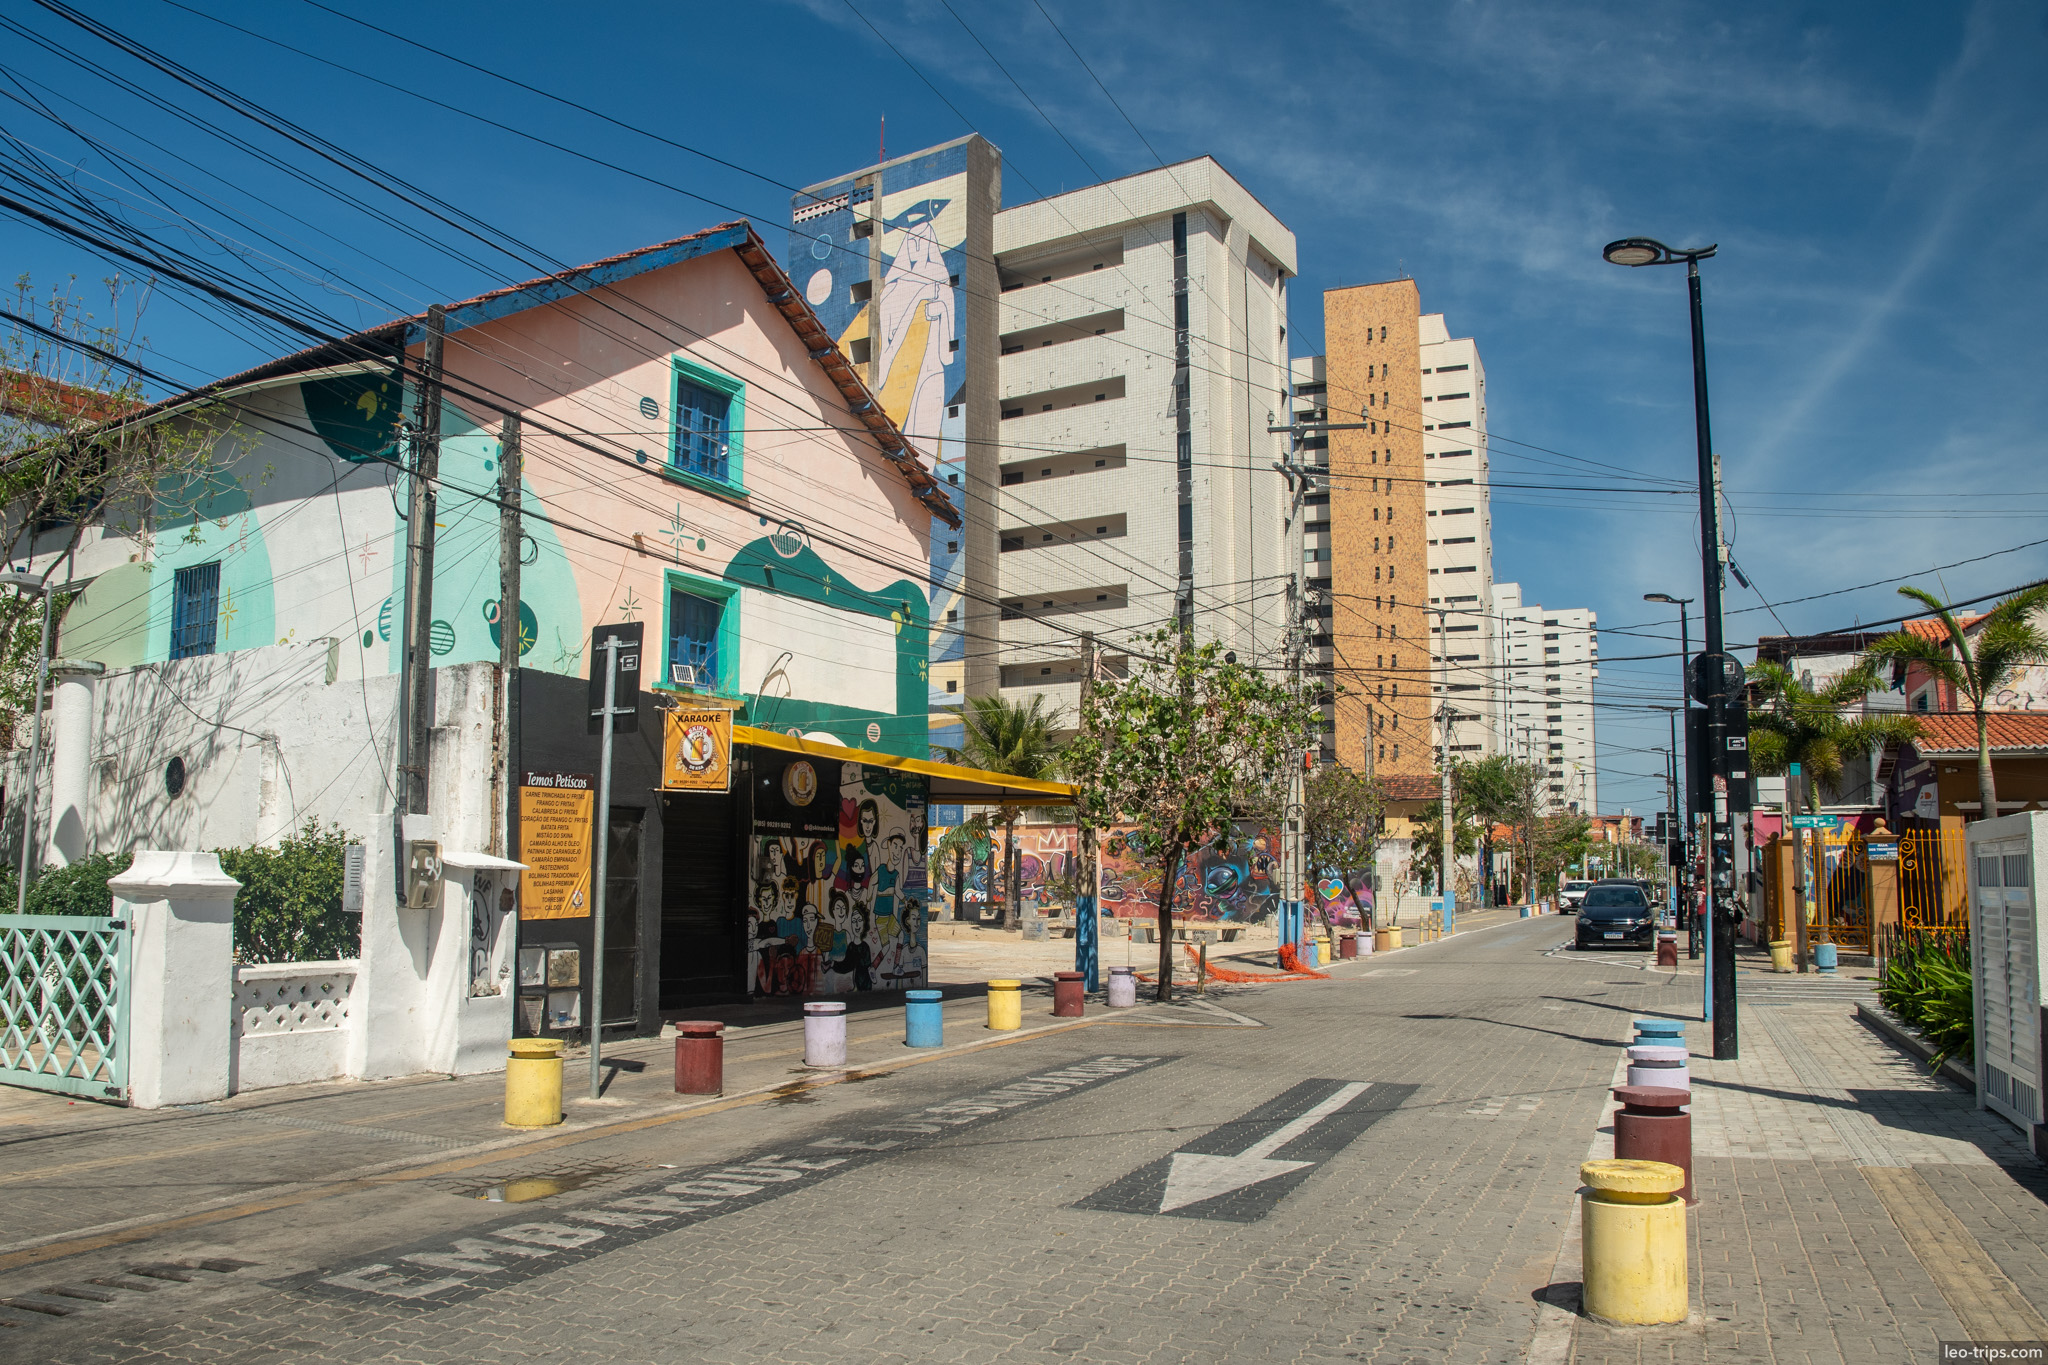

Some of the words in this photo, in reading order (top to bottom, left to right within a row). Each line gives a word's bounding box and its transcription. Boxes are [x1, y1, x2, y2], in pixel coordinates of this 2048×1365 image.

[677, 713, 721, 722] KARAOKÊ
[689, 725, 707, 734] SKINA
[527, 772, 553, 786] Temos
[555, 774, 587, 788] Petiscos
[319, 1152, 850, 1298] EMBARQUE
